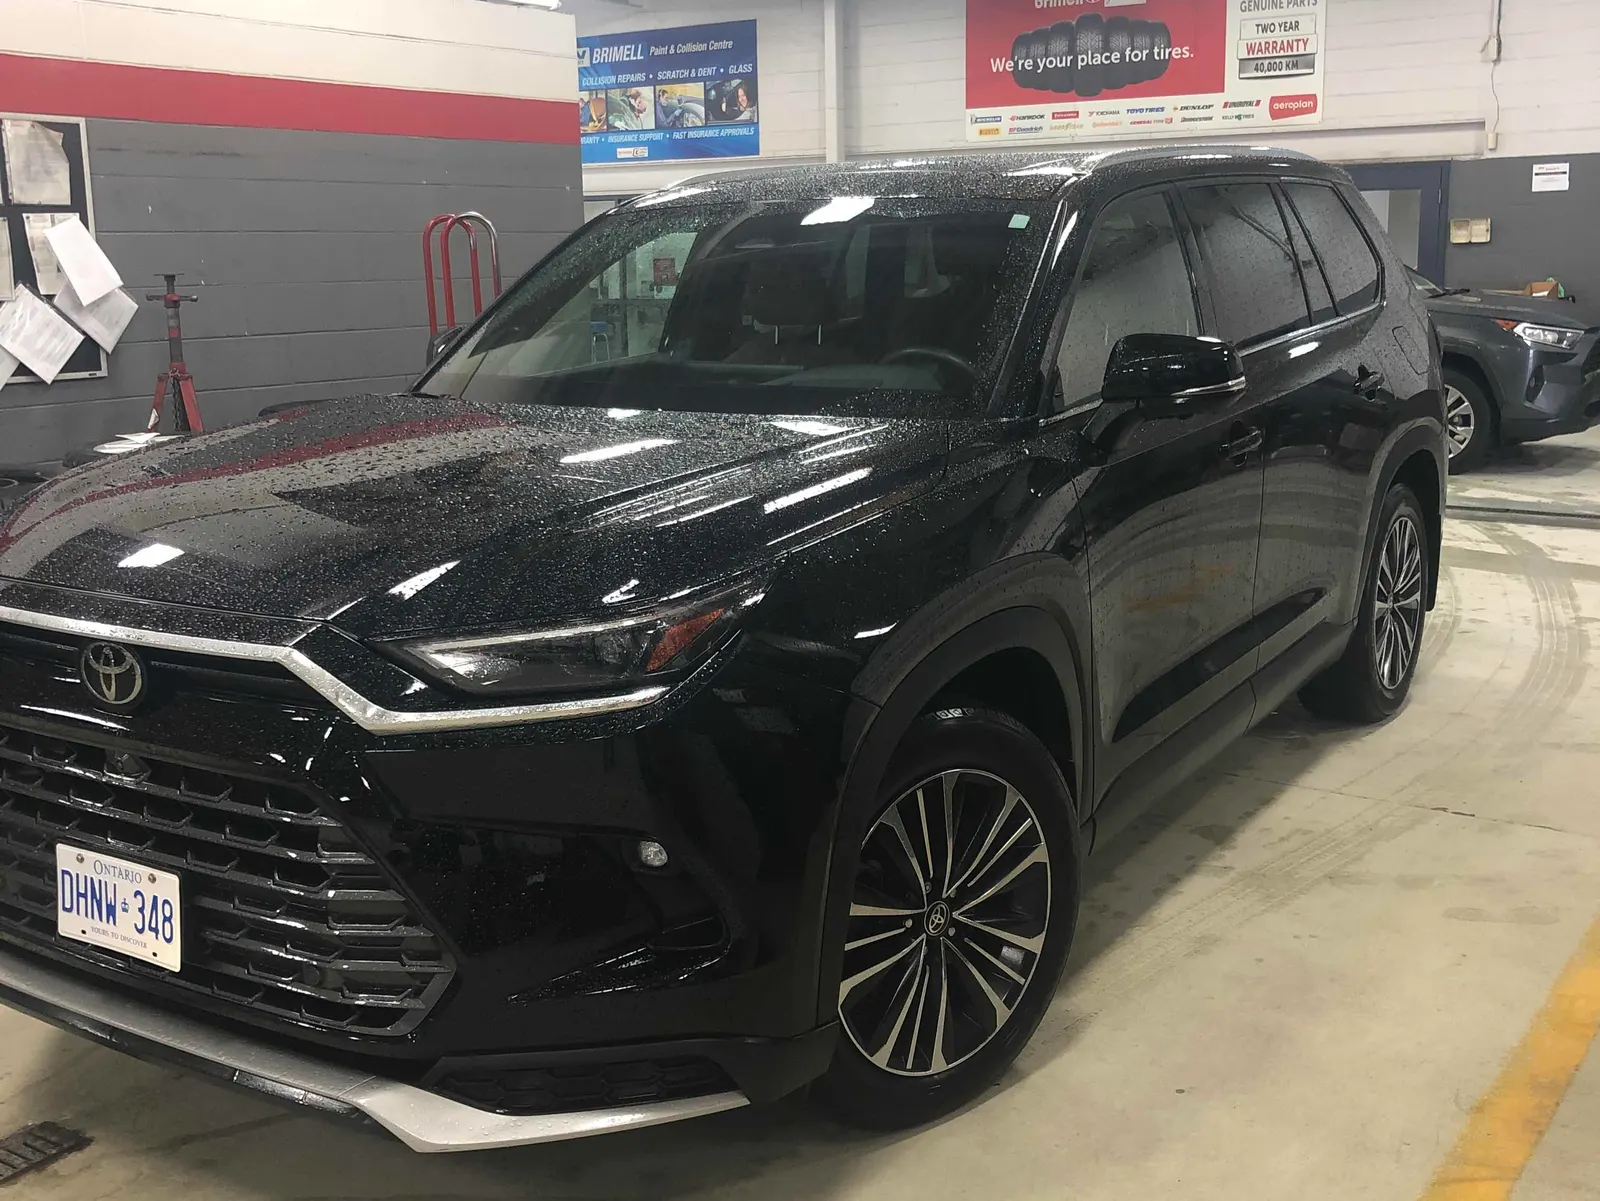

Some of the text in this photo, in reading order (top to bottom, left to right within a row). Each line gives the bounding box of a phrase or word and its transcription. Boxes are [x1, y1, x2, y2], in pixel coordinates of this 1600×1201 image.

[1240, 0, 1284, 13] GENUINE
[1255, 20, 1300, 35] TWO YEAR
[592, 44, 645, 64] BRIMELL
[649, 45, 668, 56] Paint
[669, 44, 675, 54] &
[677, 42, 707, 54] Collision
[708, 40, 733, 51] Centre
[1246, 37, 1310, 56] WARRANTY
[990, 45, 1194, 73] We're your place for tires.
[657, 66, 717, 81] SCRATCH & DENT
[728, 63, 753, 75] GLASS
[1253, 60, 1299, 75] 40,000 KM
[582, 72, 646, 87] COLLISION REPAIRS
[1273, 99, 1314, 111] aeroplan
[607, 132, 664, 144] INSURANCE SUPPORT
[672, 127, 755, 140] FAST INSURANCE APPROVALS
[61, 869, 174, 944] DHNW 348
[91, 925, 148, 949] YOURS TO DISCOVER
